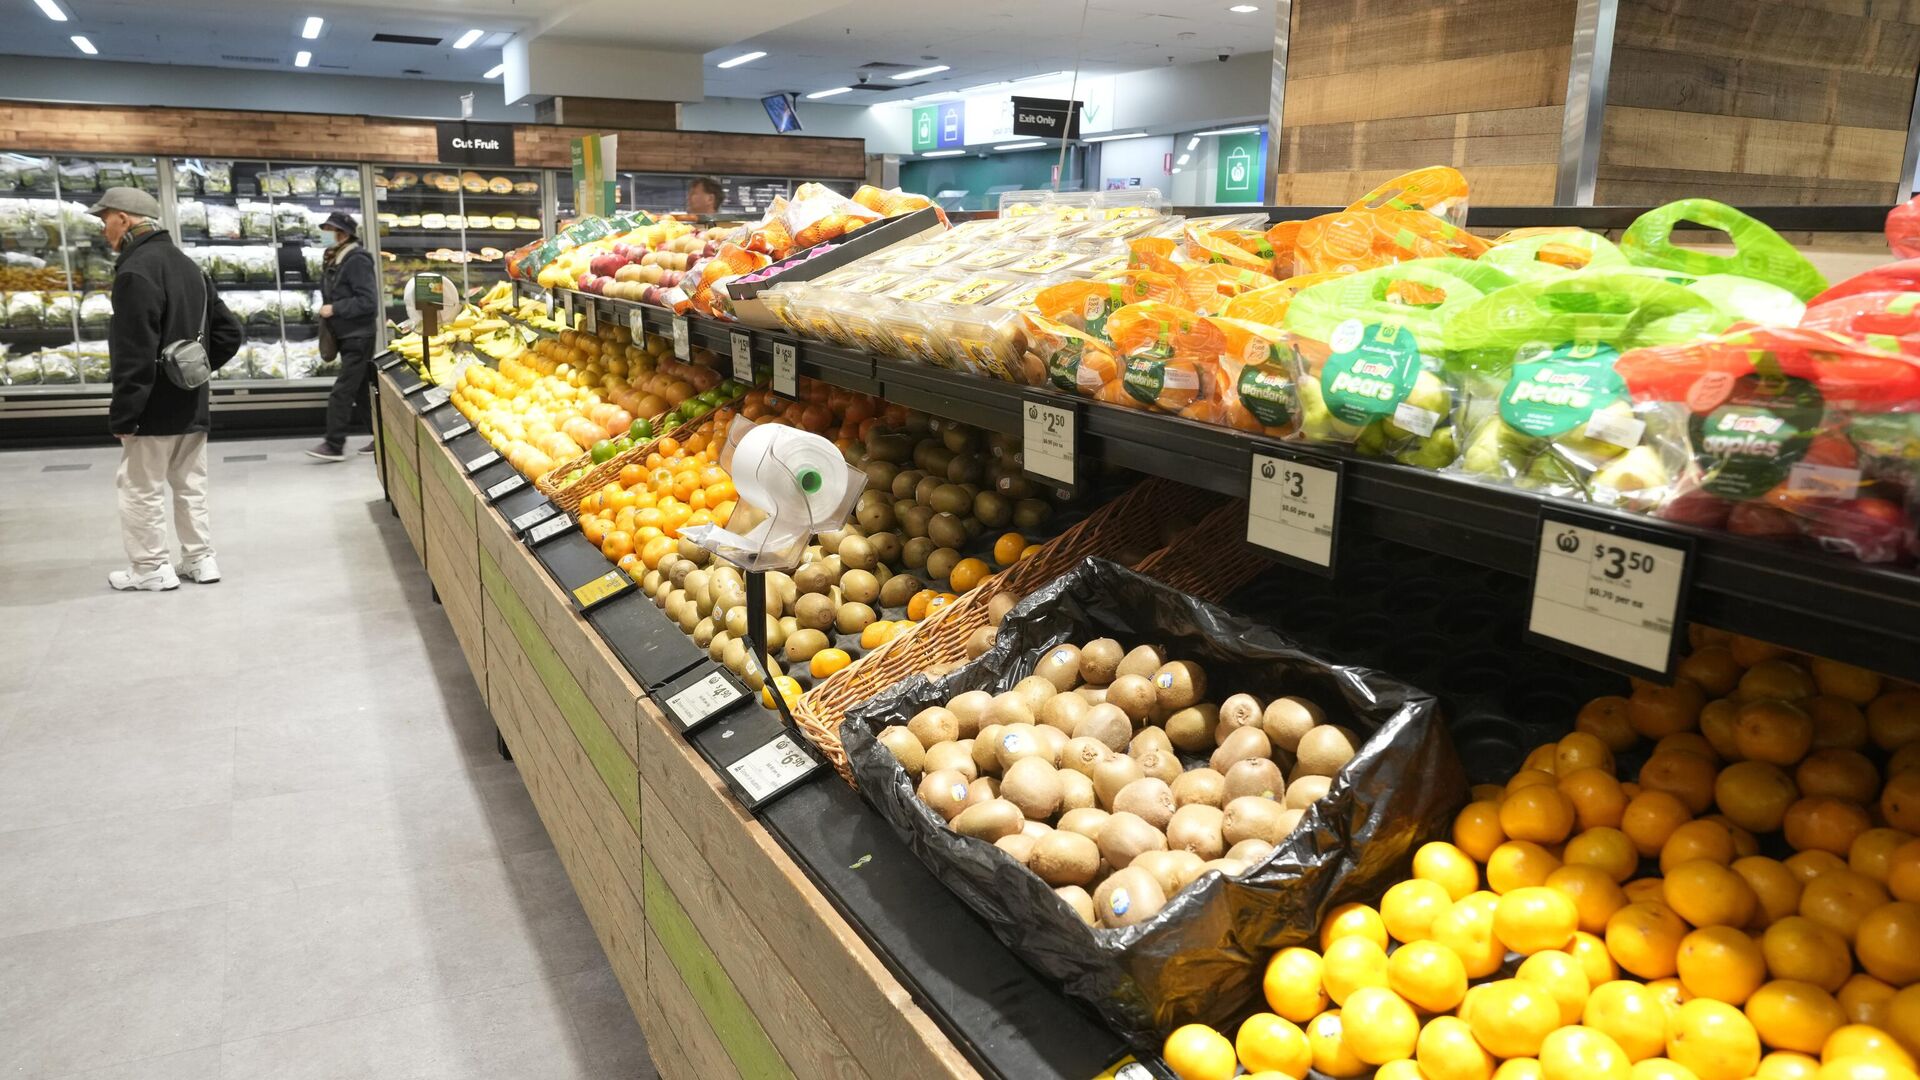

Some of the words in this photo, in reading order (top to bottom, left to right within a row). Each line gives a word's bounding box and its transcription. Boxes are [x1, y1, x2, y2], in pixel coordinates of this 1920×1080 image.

[1018, 114, 1036, 124] Exit
[1036, 114, 1056, 127] Only
[452, 138, 473, 149] Cut
[474, 138, 500, 150] Fruit
[1329, 371, 1395, 401] pears
[1509, 381, 1593, 409] pears
[1703, 434, 1783, 458] apples
[1284, 470, 1304, 498] $3
[1298, 508, 1307, 517] per
[1615, 595, 1631, 606] per
[1632, 600, 1644, 609] ea
